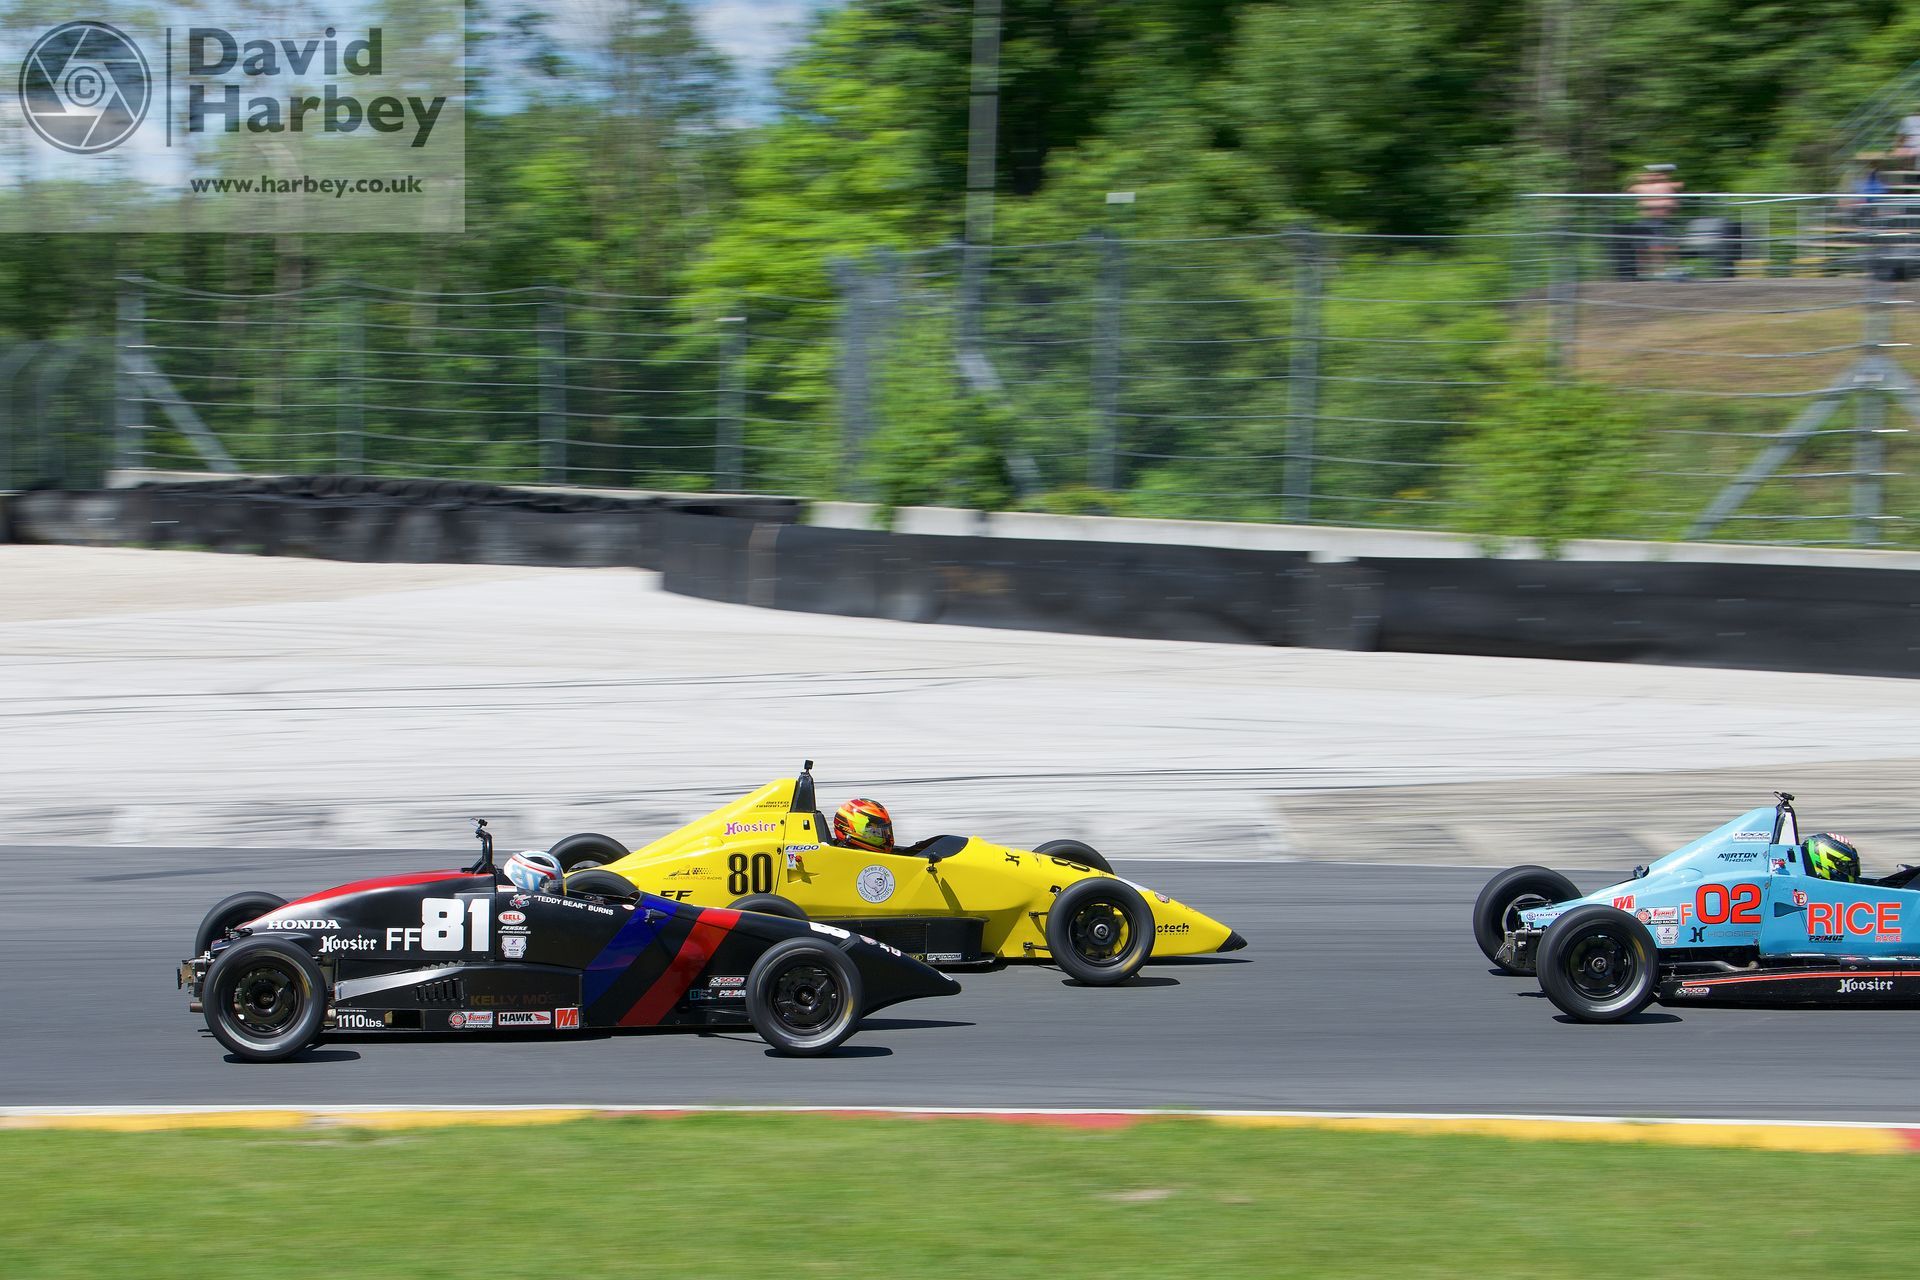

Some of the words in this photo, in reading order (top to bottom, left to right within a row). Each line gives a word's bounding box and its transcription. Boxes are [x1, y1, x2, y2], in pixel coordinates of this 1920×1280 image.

[724, 820, 776, 836] Hoosier
[1717, 852, 1759, 861] AYRTON
[727, 852, 772, 895] 80
[533, 895, 561, 905] "TEDDY
[562, 899, 587, 910] BEAR"
[588, 905, 614, 916] BURNS
[1695, 883, 1761, 925] 02
[266, 919, 342, 930] HONDA
[421, 897, 489, 951] 81
[1807, 901, 1902, 936] RICE
[318, 934, 378, 953] Hoosier
[386, 927, 421, 951] FF
[1875, 935, 1901, 943] RACE
[1837, 978, 1893, 993] Hoosier
[470, 994, 517, 1006] KELLY
[500, 1013, 533, 1022] HAWK
